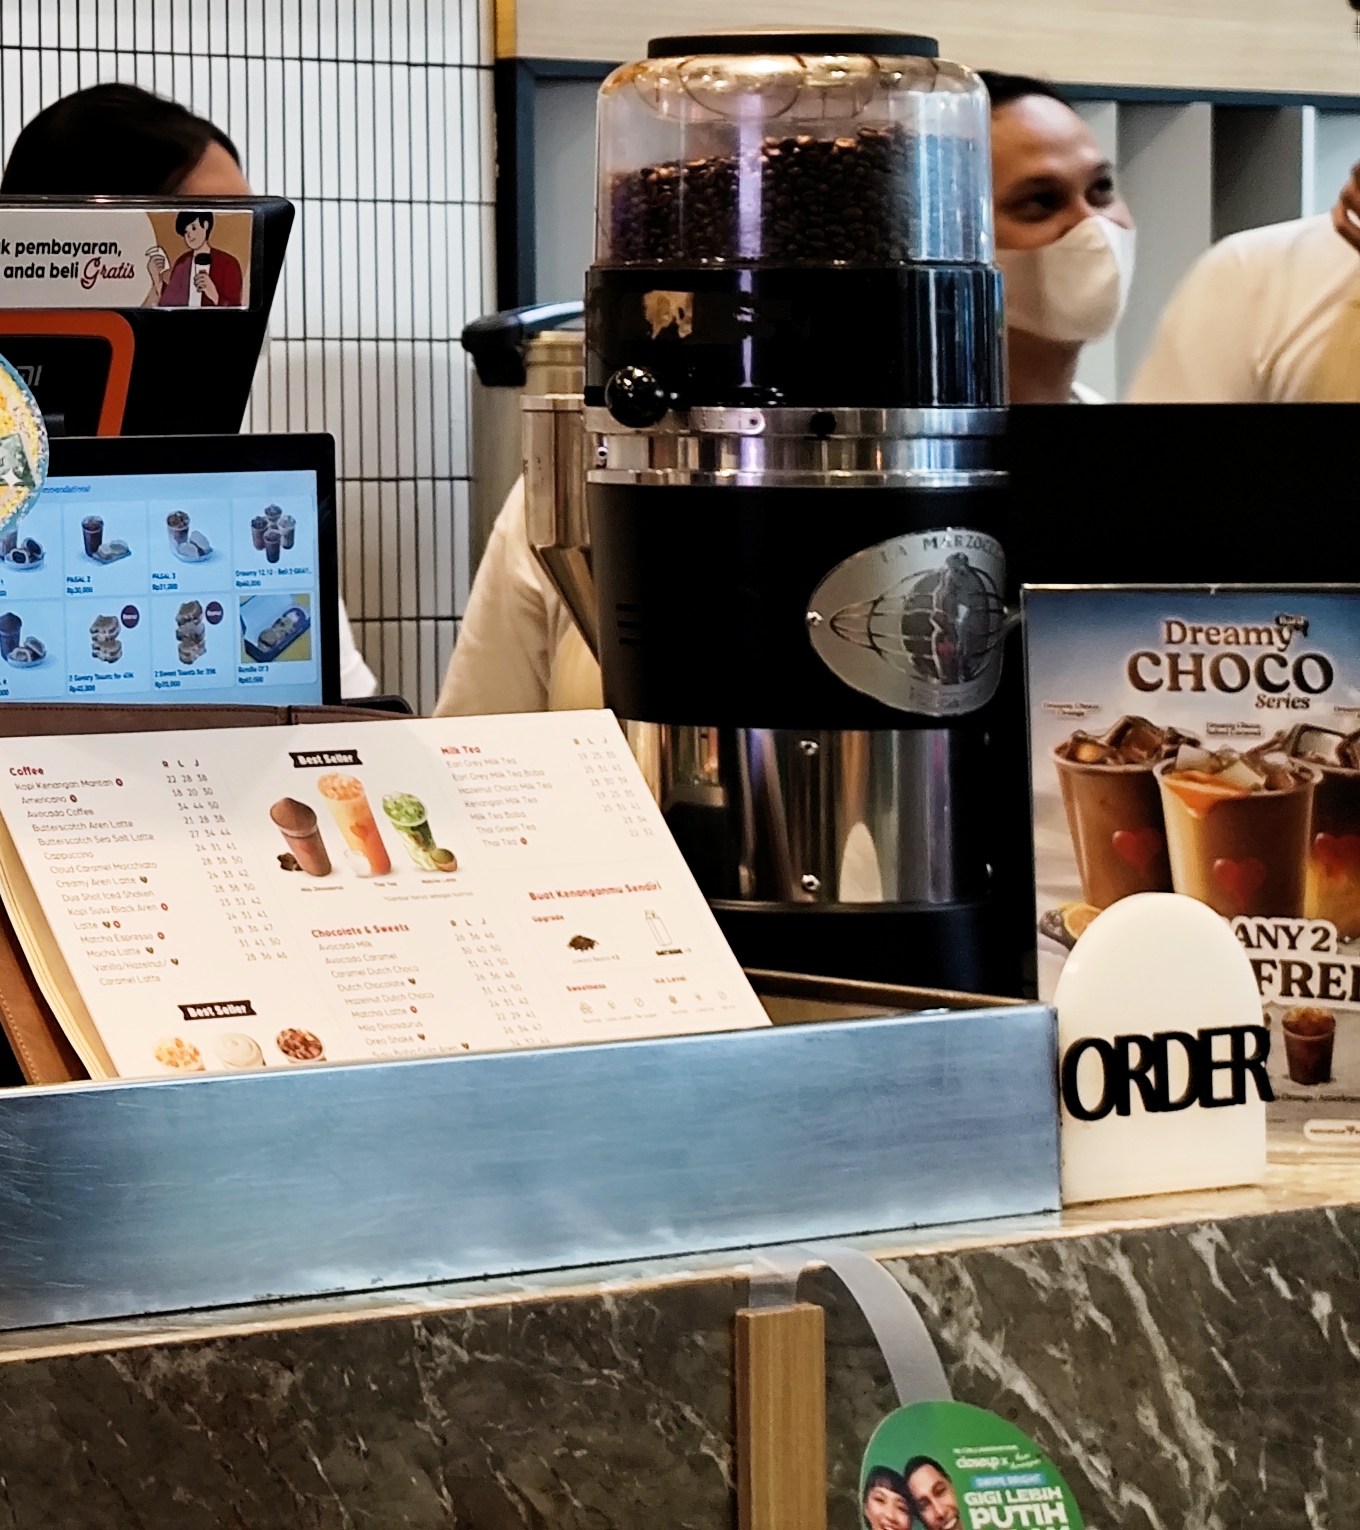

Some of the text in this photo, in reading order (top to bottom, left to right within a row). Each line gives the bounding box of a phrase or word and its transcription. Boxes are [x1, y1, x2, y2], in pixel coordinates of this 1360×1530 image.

[15, 238, 122, 258] pembayaran,
[3, 262, 45, 280] anda
[49, 261, 80, 279] beli
[80, 257, 135, 290] Gratis
[1164, 619, 1292, 652] Dreamy
[1127, 650, 1334, 694] CHOCO
[1254, 692, 1310, 709] Series
[297, 752, 354, 765] Best Seller
[441, 745, 481, 755] Milk Tea
[9, 766, 44, 776] Coffee
[528, 891, 555, 901] Buat
[311, 927, 363, 938] Chocolate
[373, 923, 410, 934] Sweets
[1235, 923, 1331, 952] ANY 2
[186, 1003, 247, 1018] Best Seller
[1061, 1024, 1275, 1123] ORDER
[964, 1485, 1064, 1506] GIGI LEBIH
[968, 1501, 1069, 1530] PUTIH
